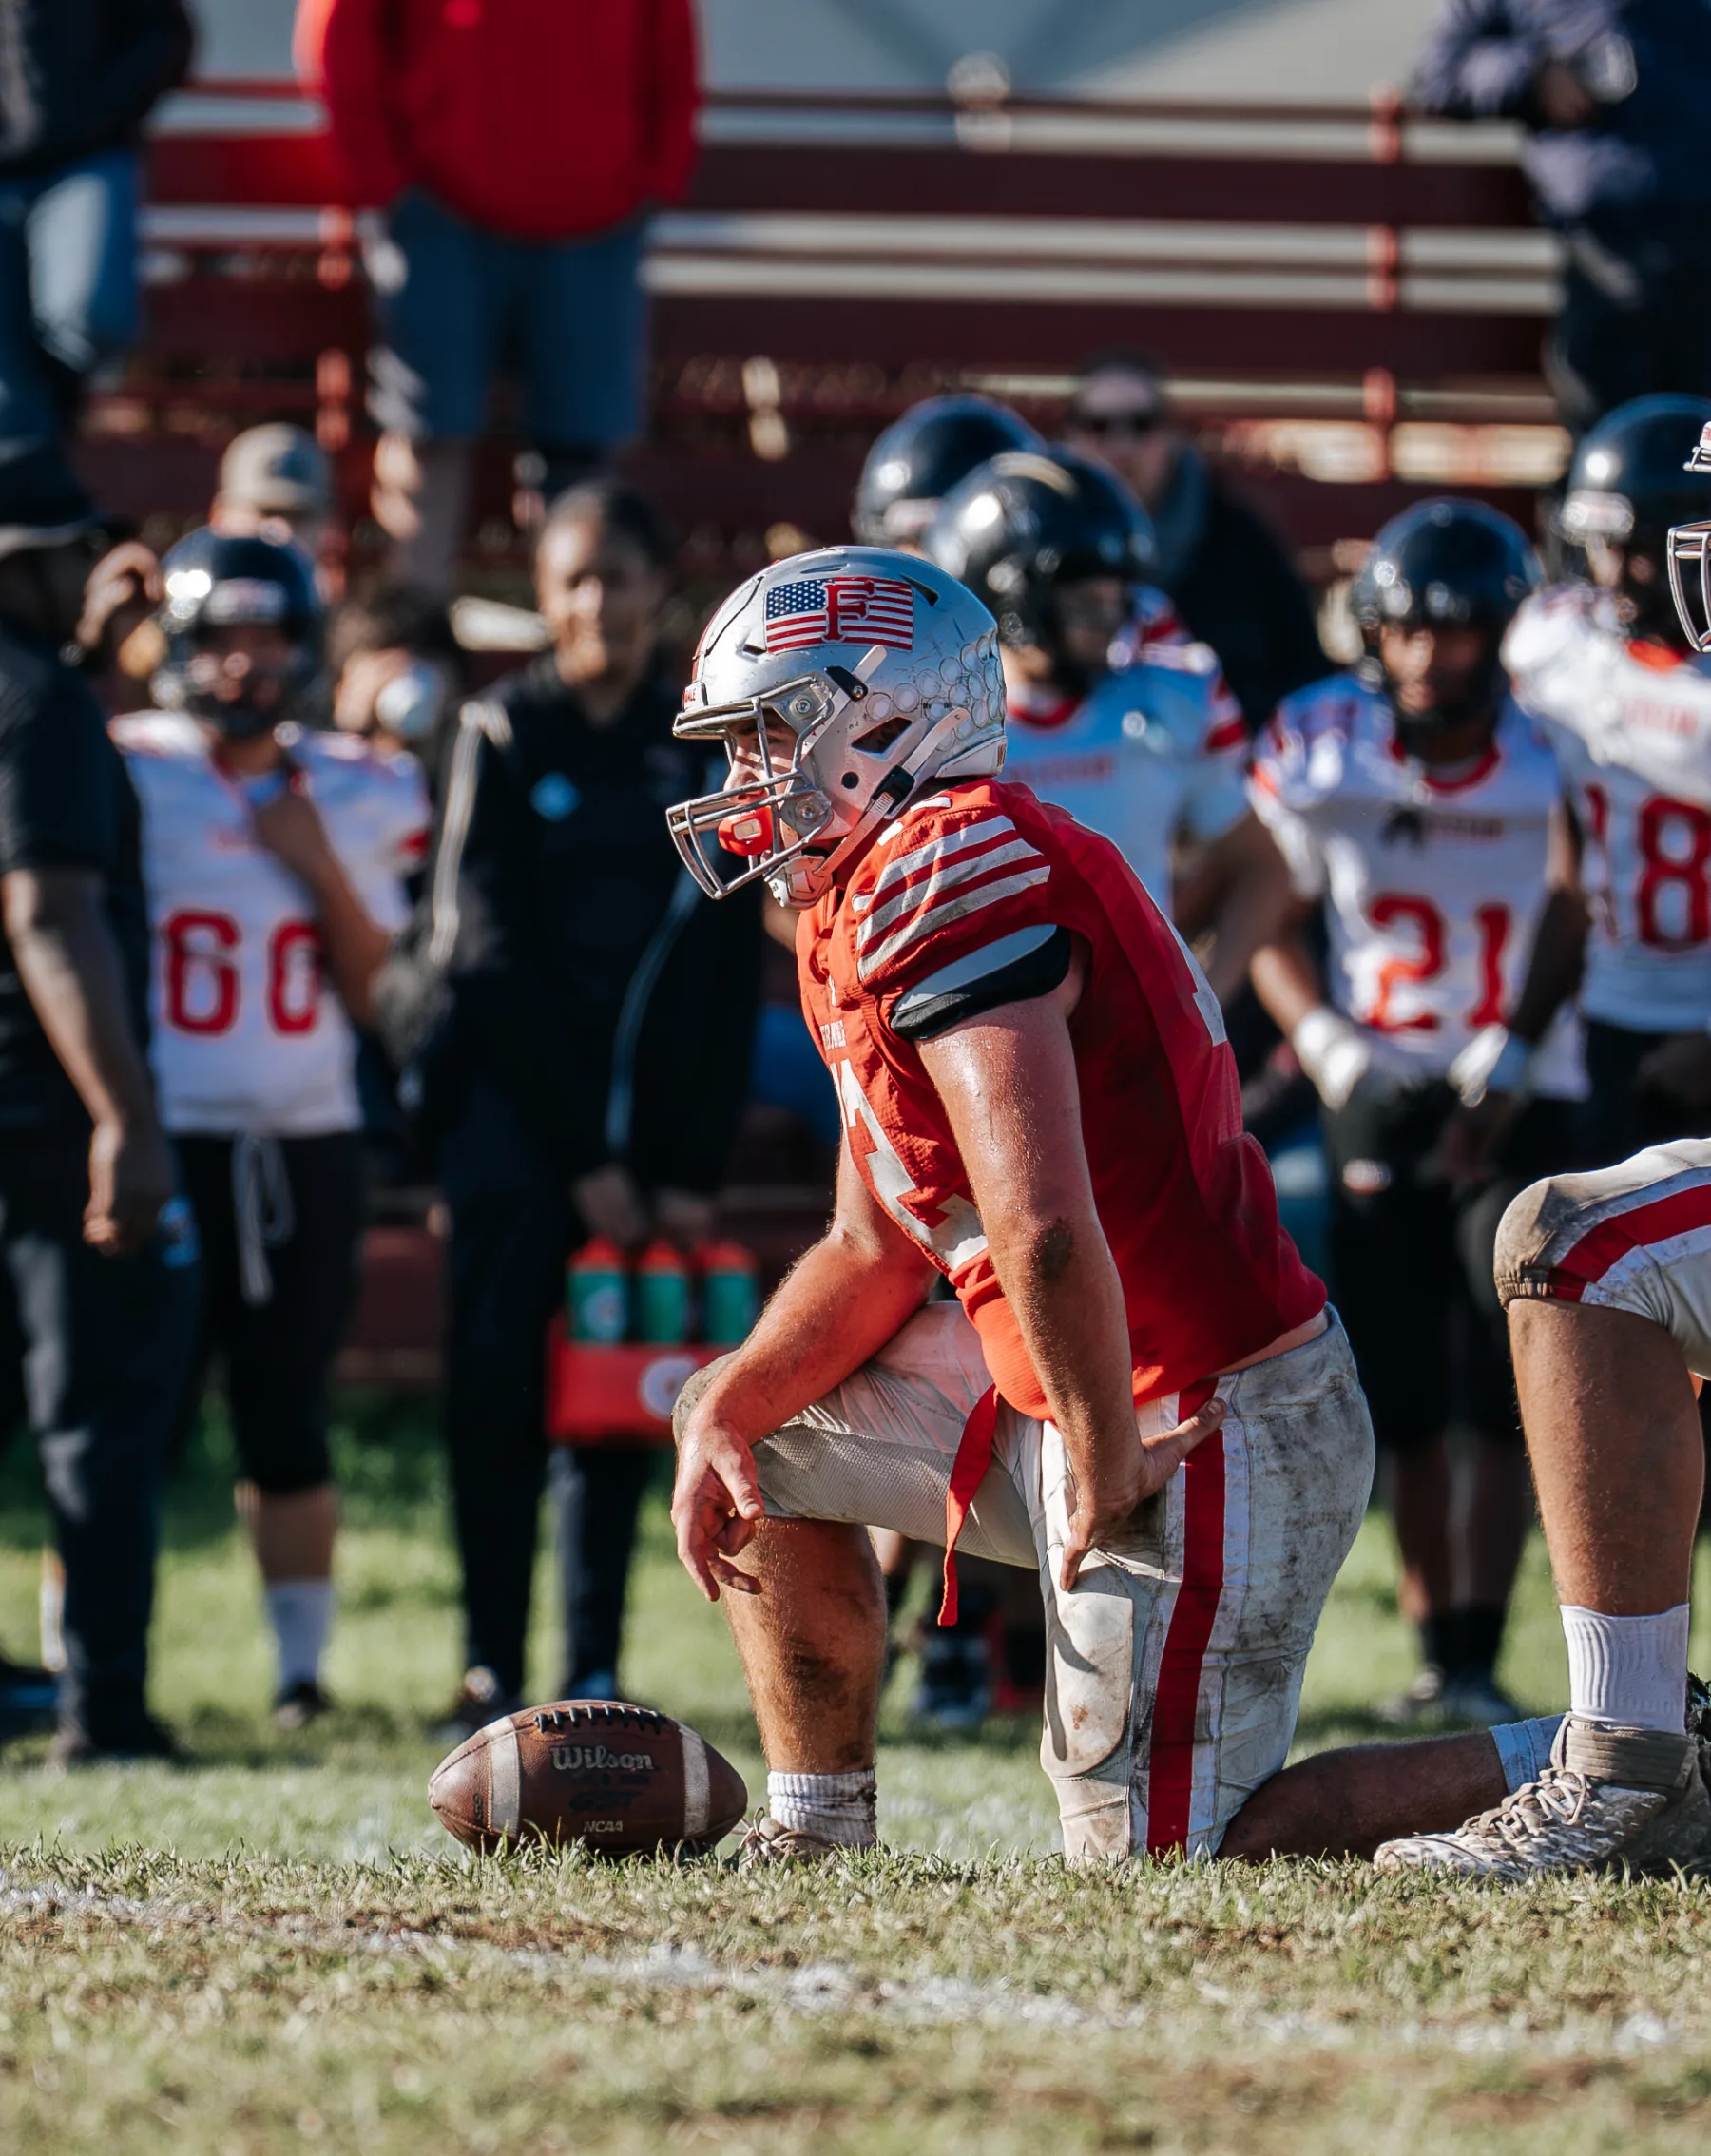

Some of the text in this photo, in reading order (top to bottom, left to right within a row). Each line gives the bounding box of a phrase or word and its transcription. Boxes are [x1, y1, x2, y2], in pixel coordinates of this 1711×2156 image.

[821, 581, 878, 644] F
[165, 907, 321, 1036] 60
[1367, 892, 1513, 1034] 21
[549, 1744, 658, 1771] Wilson
[583, 1820, 624, 1833] NCAA
